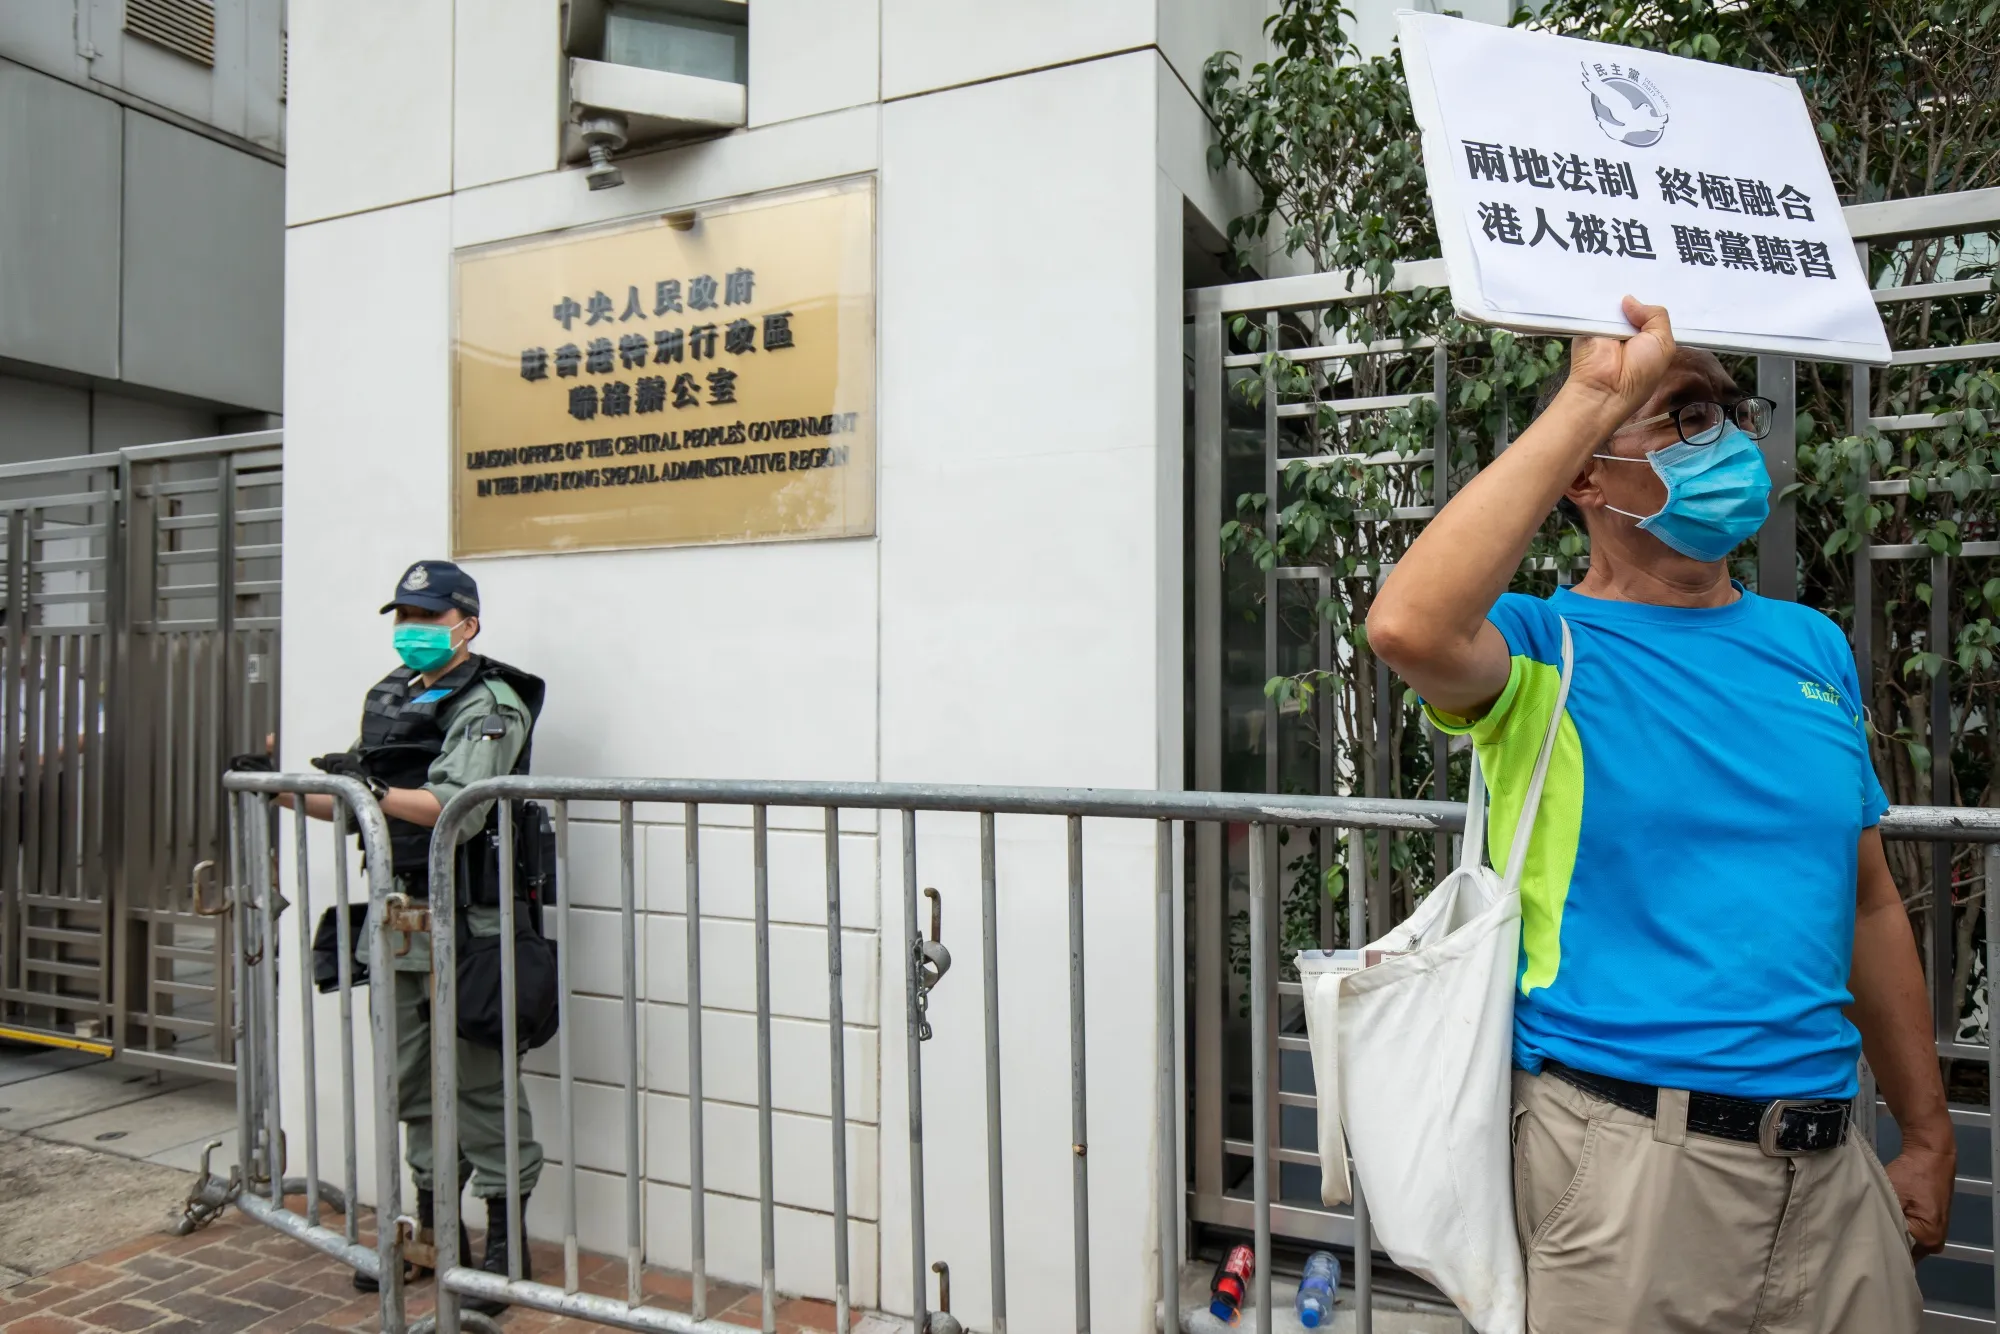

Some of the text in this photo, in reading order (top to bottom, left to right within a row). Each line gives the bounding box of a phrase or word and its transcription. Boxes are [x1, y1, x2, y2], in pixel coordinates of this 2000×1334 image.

[1593, 62, 1640, 82] 民主黨
[1461, 139, 1815, 222] 兩地法制 終極融合
[1477, 201, 1837, 280] 港人被迫 聽黨聽習
[553, 267, 756, 331] 中央人民政府
[520, 311, 795, 382] 駐香港特別行政區
[568, 367, 738, 420] 聯絡辦公室
[467, 448, 517, 469] LIAISON
[518, 443, 565, 464] OFFICE
[565, 441, 585, 460] OF
[586, 438, 613, 458] THE
[615, 431, 681, 455] CENTRAL
[748, 412, 857, 442] GOVERNMENT
[477, 446, 850, 497] IN THE HONG KONG SPECIAL ADMINISTRATIVE REGION
